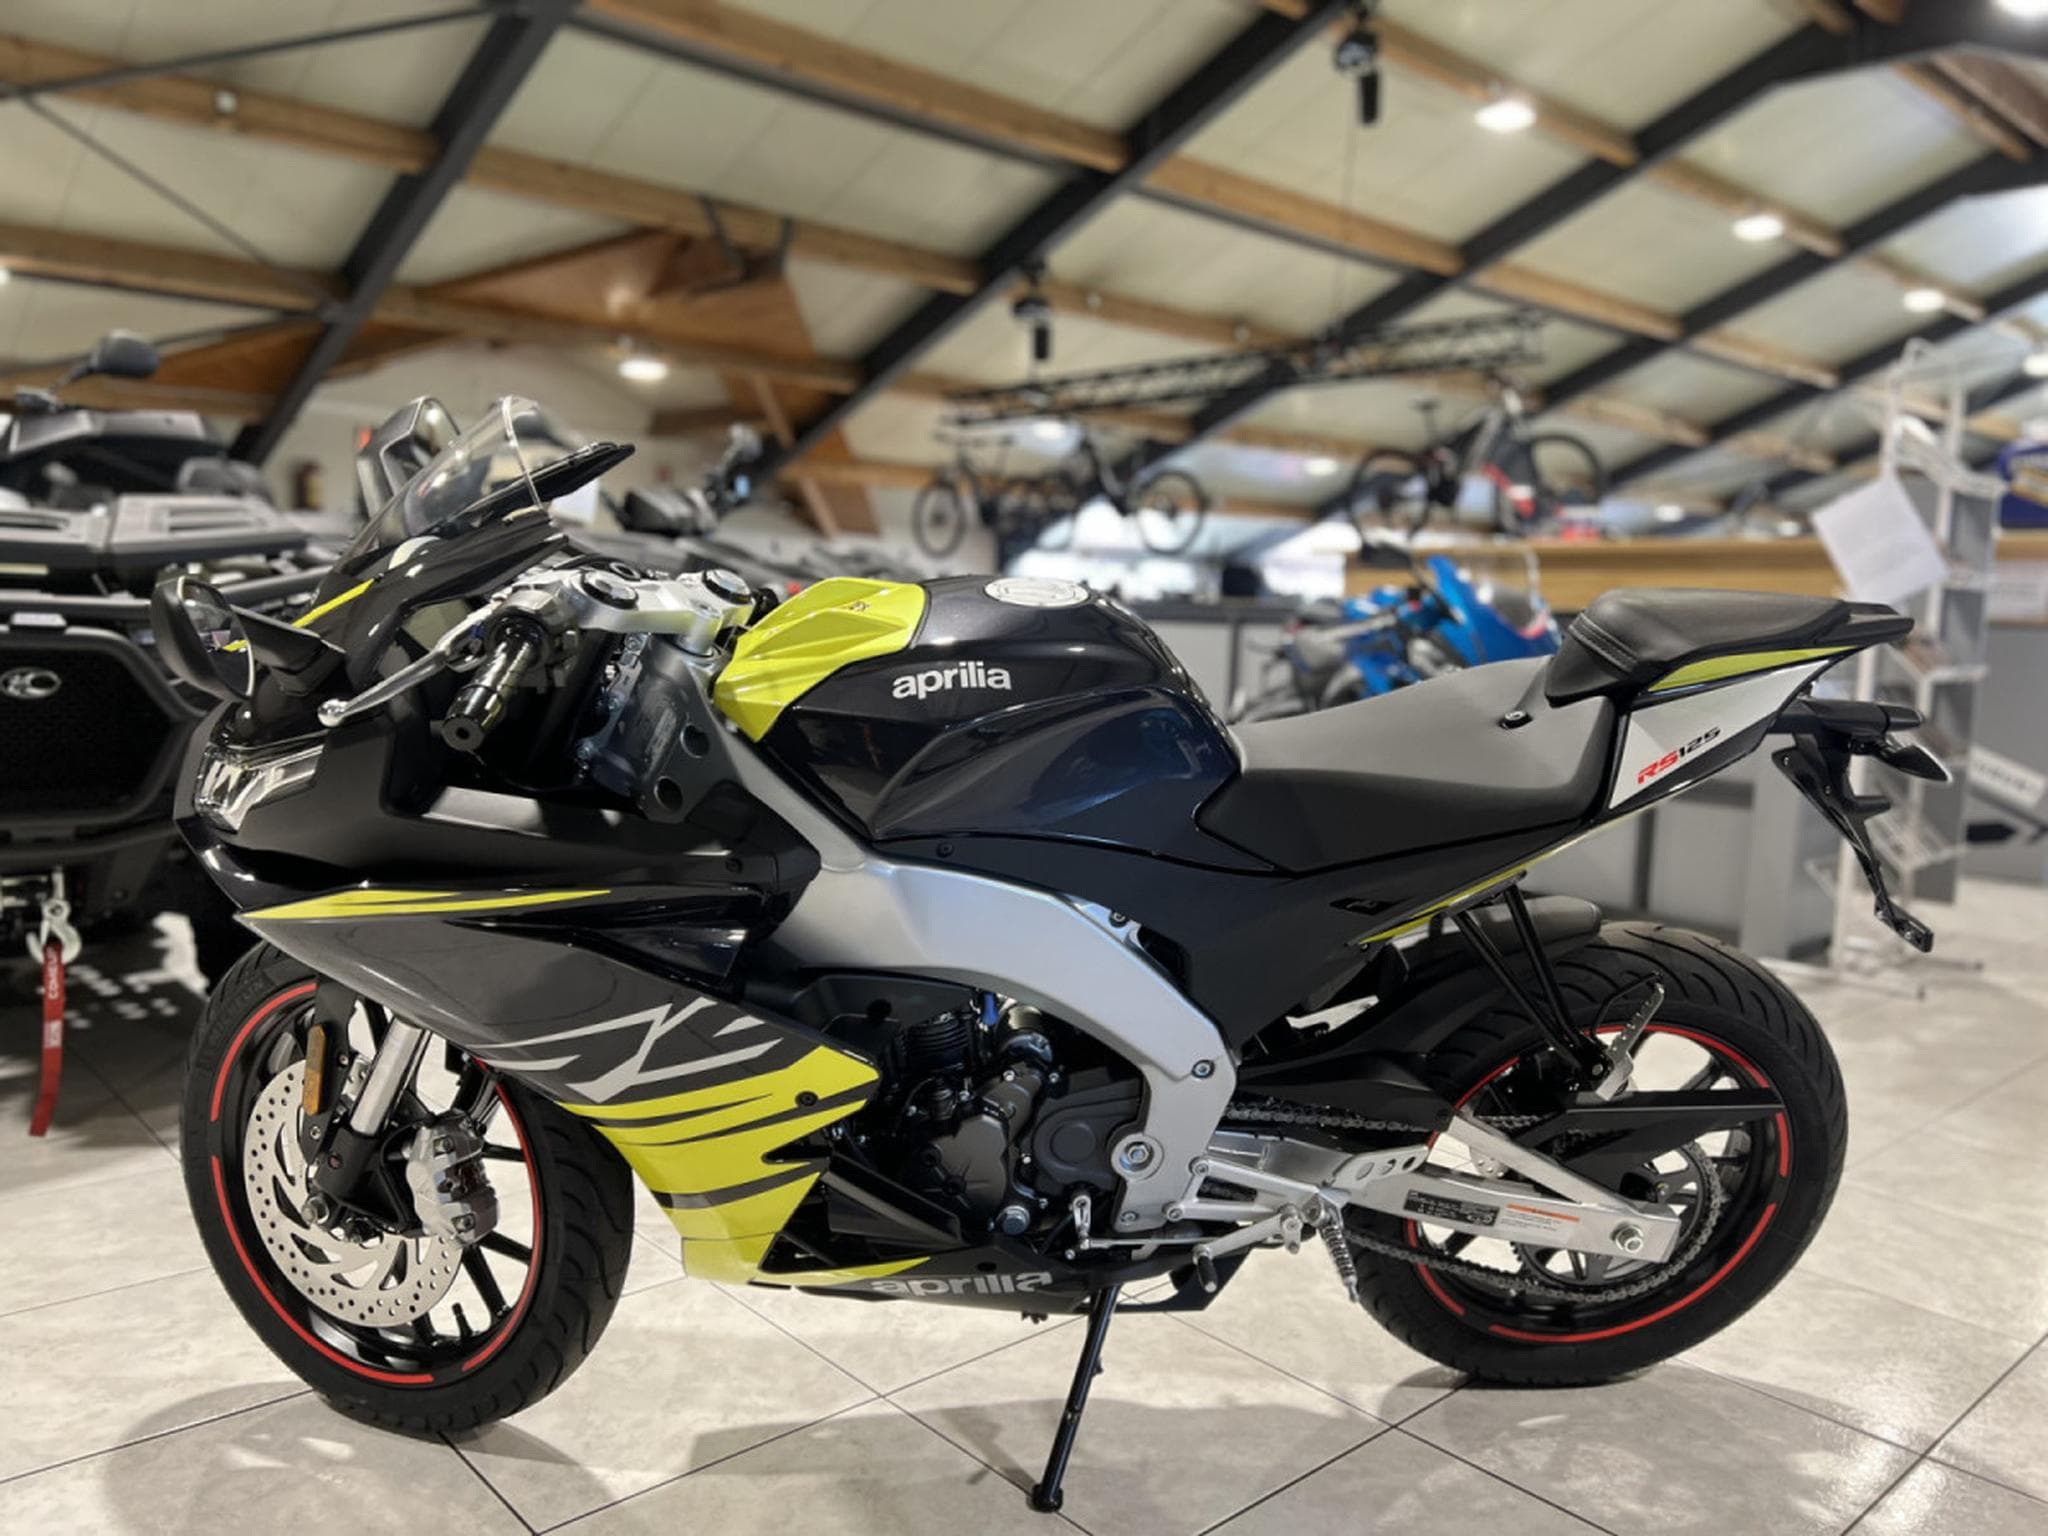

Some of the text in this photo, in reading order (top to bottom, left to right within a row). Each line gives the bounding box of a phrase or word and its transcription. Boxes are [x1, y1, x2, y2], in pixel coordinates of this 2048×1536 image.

[892, 660, 1012, 700] aprilia
[1637, 726, 1721, 784] RS125
[871, 1272, 1052, 1296] aprilia
